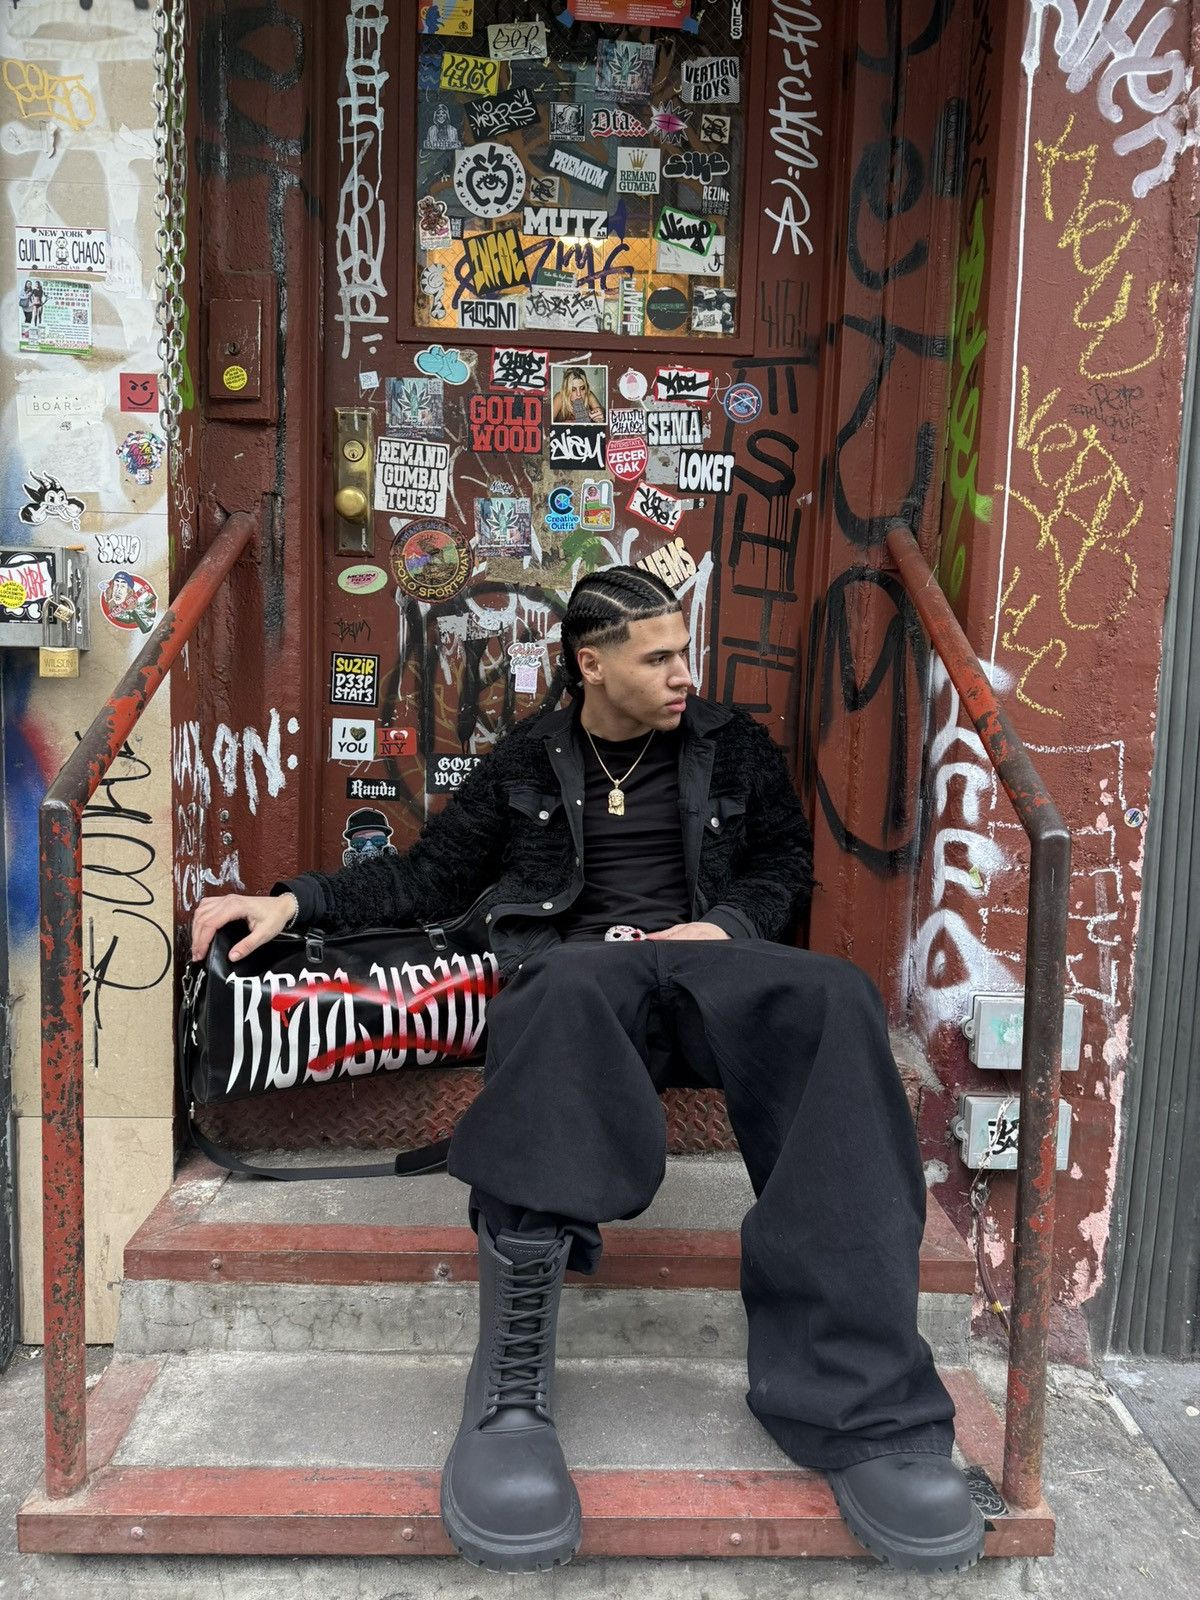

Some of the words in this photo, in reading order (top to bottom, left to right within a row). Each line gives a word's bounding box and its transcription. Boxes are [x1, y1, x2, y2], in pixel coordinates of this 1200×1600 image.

[685, 58, 739, 85] VERTIGO
[691, 76, 730, 103] BOYS
[457, 156, 472, 175] THE
[505, 153, 522, 175] CLAY
[620, 170, 657, 183] REMAND
[619, 181, 657, 195] GUMBA
[702, 185, 730, 203] REZINE
[460, 188, 523, 216] UNIVERSE
[524, 206, 608, 237] MUTZ
[38, 229, 60, 238] NEW
[62, 230, 85, 239] YORK
[18, 238, 54, 263] GUILTY
[71, 240, 105, 265] CHAOS
[469, 395, 543, 427] GOLD
[472, 424, 543, 453] WOOD
[648, 411, 702, 446] SEMA
[379, 440, 448, 469] REMAND
[608, 449, 647, 465] ZECER
[616, 461, 640, 475] GAK
[679, 452, 735, 493] LOKET
[383, 464, 440, 493] GUMBA
[386, 486, 437, 514] TCU33
[546, 514, 579, 523] Creative
[551, 522, 575, 532] Outfit
[394, 559, 418, 591] POLO
[418, 548, 469, 598] SPORTSMAN
[335, 673, 374, 689] D33P
[341, 726, 346, 740] I
[382, 729, 390, 741] I
[338, 741, 368, 756] YOU
[380, 742, 407, 756] NY
[350, 779, 397, 799] Randa
